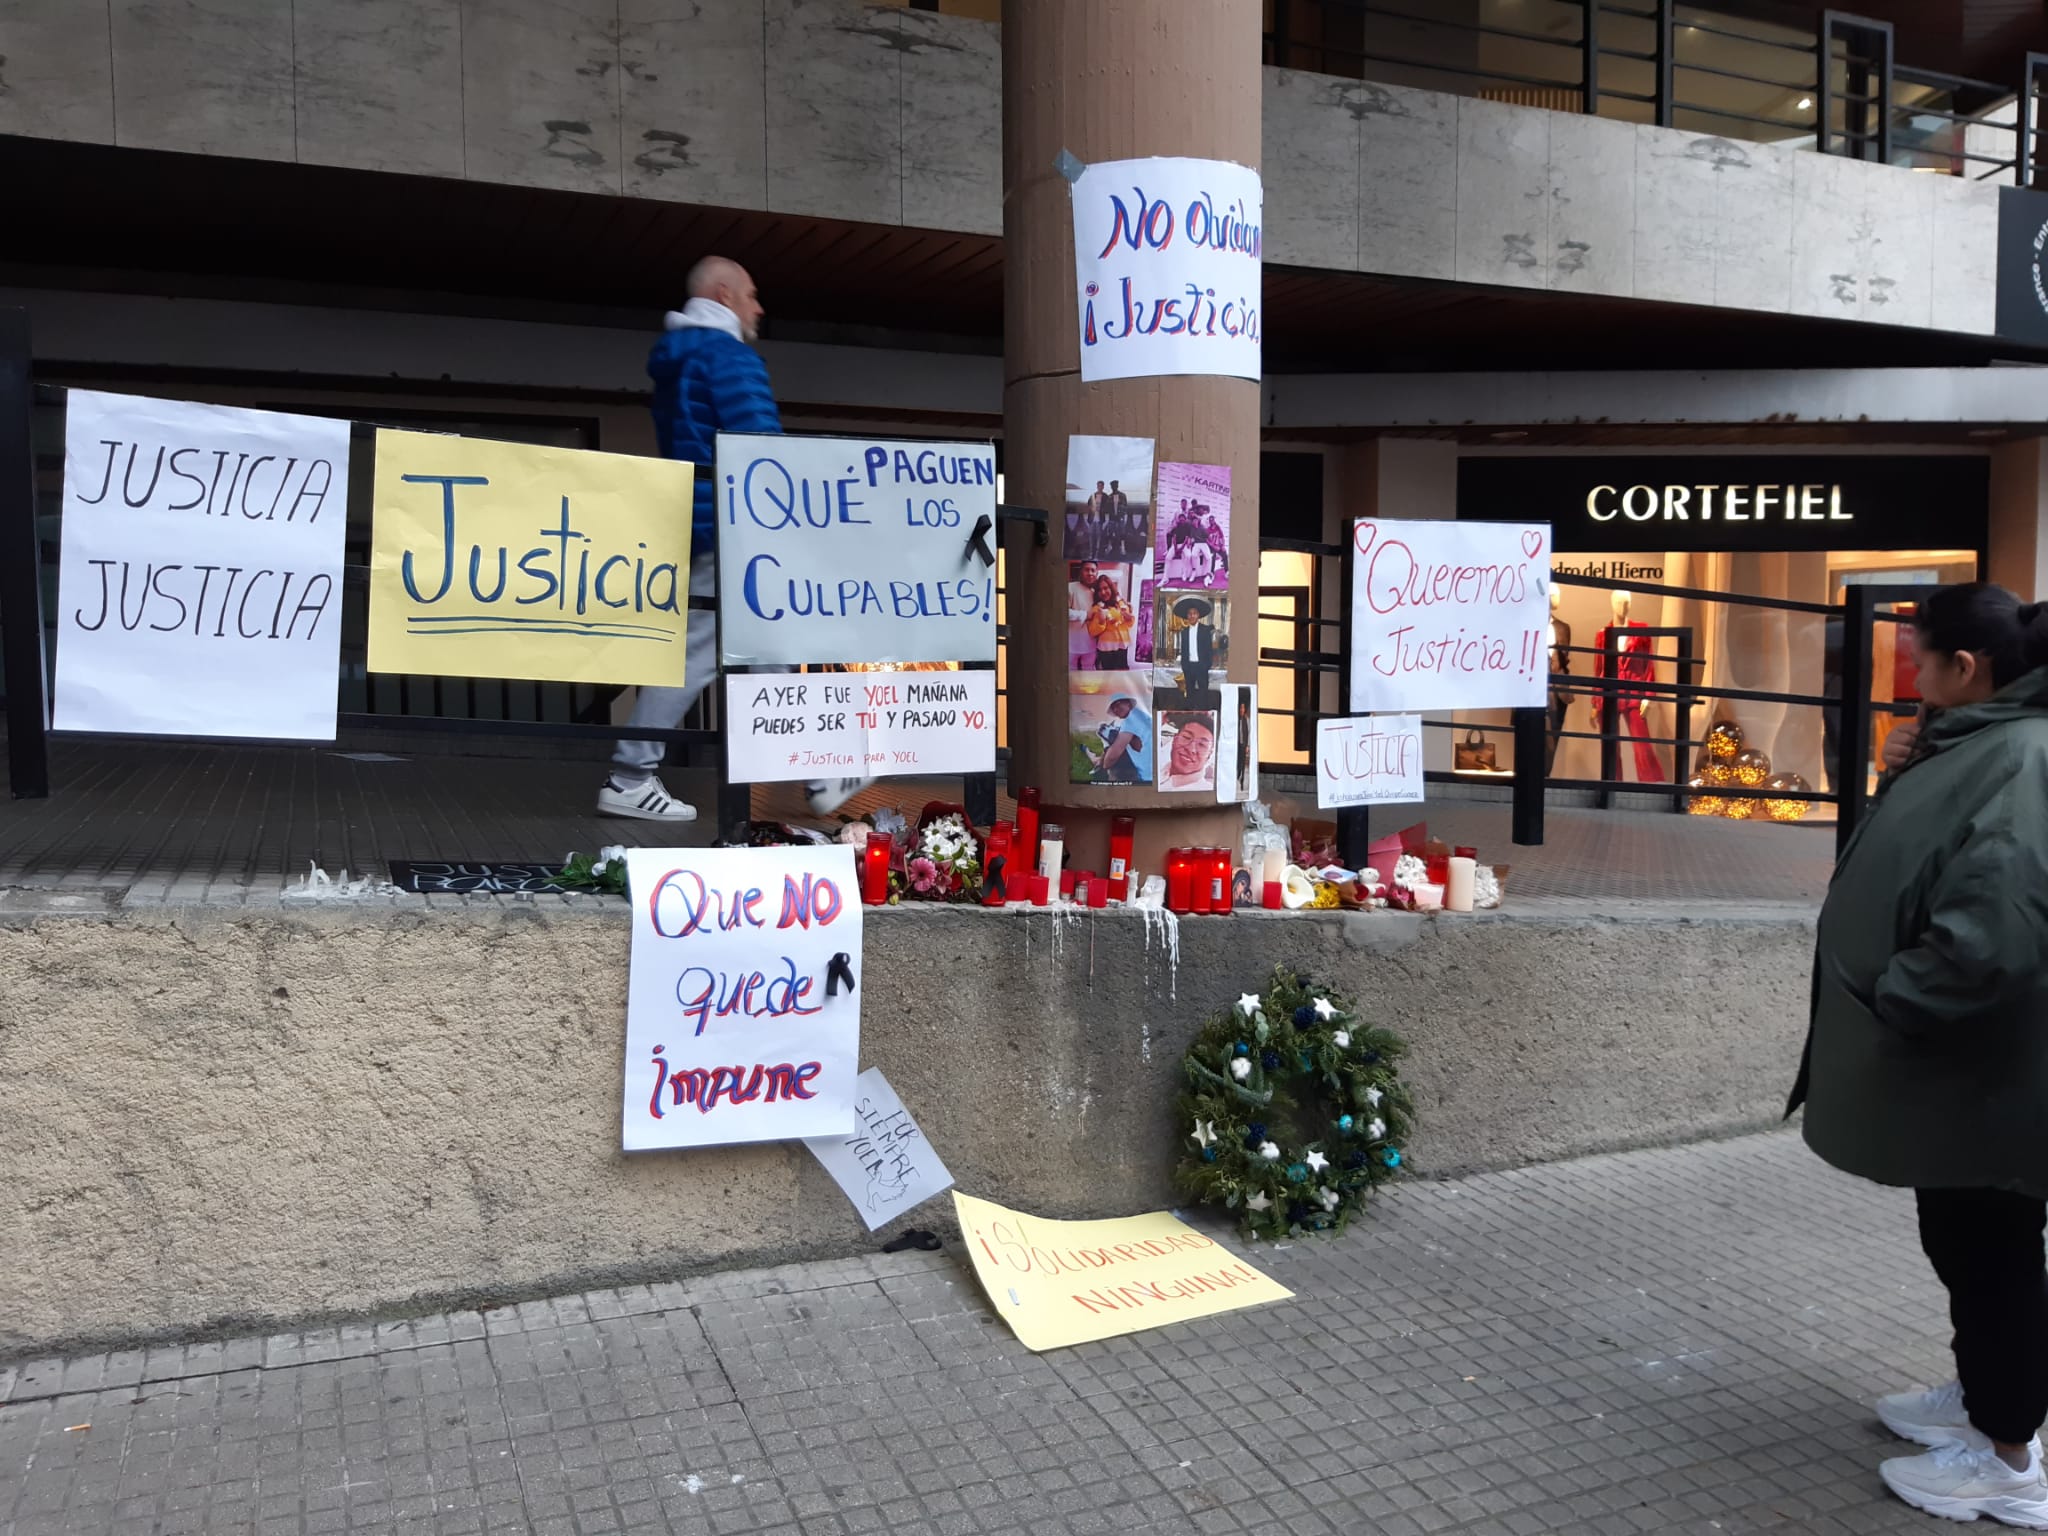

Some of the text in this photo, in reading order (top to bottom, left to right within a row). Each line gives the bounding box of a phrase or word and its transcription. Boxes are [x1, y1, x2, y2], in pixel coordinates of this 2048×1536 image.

[1098, 187, 1174, 260] NO
[75, 440, 333, 524] JUSTICIA
[864, 446, 995, 487] PAGUEN
[906, 498, 961, 527] LOS
[1586, 484, 1854, 521] CORTEFIEL
[401, 473, 681, 617] Justicia
[743, 553, 993, 623] CULPABLES!
[1367, 539, 1528, 614] Queremos
[1554, 561, 1663, 579] dro del Hierro
[73, 558, 333, 640] JUSTICIA
[752, 685, 808, 708] AYER
[824, 686, 851, 704] FUE
[907, 681, 968, 704] MAÑANA
[752, 716, 805, 735] PUEDES
[817, 712, 846, 732] SER
[856, 709, 877, 729] TÚ
[887, 711, 897, 729] Y
[903, 709, 956, 729] PASADO
[893, 751, 918, 764] YOEL
[409, 863, 563, 879] JUST
[649, 868, 843, 938] Que NO
[854, 1097, 921, 1180] SIEMPRE
[885, 1110, 920, 1149] POR
